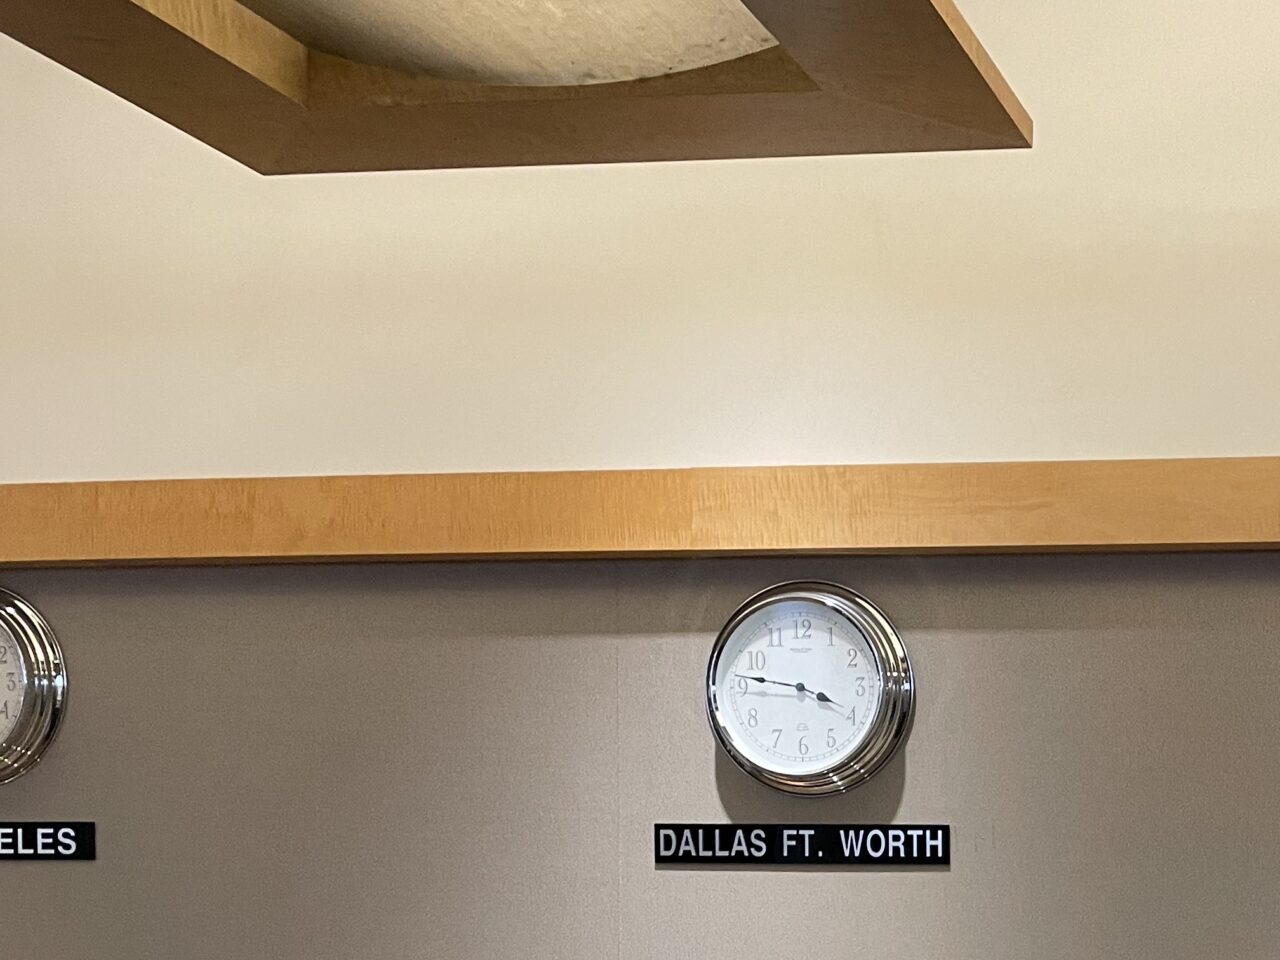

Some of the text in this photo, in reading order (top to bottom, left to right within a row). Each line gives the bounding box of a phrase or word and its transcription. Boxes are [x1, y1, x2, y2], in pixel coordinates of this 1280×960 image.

[767, 627, 784, 647] 11
[792, 618, 812, 640] 12
[826, 627, 835, 647] 1
[747, 650, 766, 671] 10
[847, 648, 858, 669] 2
[6, 672, 16, 691] 3
[738, 679, 748, 697] 9
[855, 676, 866, 696] 3
[748, 708, 758, 728] 8
[846, 706, 856, 726] 4
[771, 729, 783, 749] 7
[799, 735, 809, 755] 6
[826, 728, 837, 748] 5
[0, 827, 77, 855] ELES
[659, 828, 943, 858] DALLAS FT. WORTH
